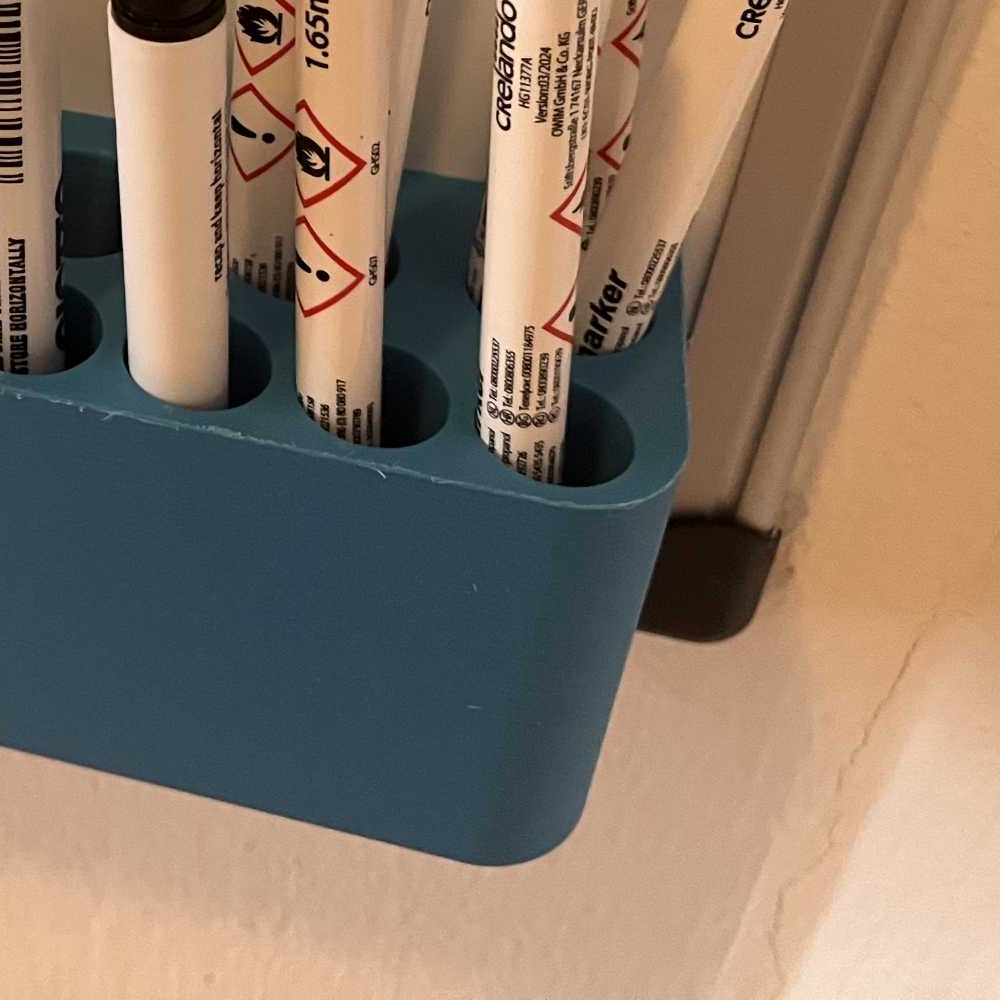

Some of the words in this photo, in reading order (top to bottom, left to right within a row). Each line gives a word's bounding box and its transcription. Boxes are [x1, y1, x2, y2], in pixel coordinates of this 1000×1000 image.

[558, 31, 570, 47] KG
[573, 18, 586, 77] Neckarsulm
[558, 64, 567, 73] &
[559, 46, 568, 64] Co.
[518, 57, 532, 108] HG11377A
[553, 74, 566, 105] GmbH
[571, 79, 580, 107] 74167
[552, 106, 564, 137] OWIM
[210, 108, 221, 186] horizontal
[210, 183, 223, 220] keep
[210, 218, 222, 242] and
[215, 243, 224, 281] recap
[8, 237, 27, 330] HORIZONTALLY
